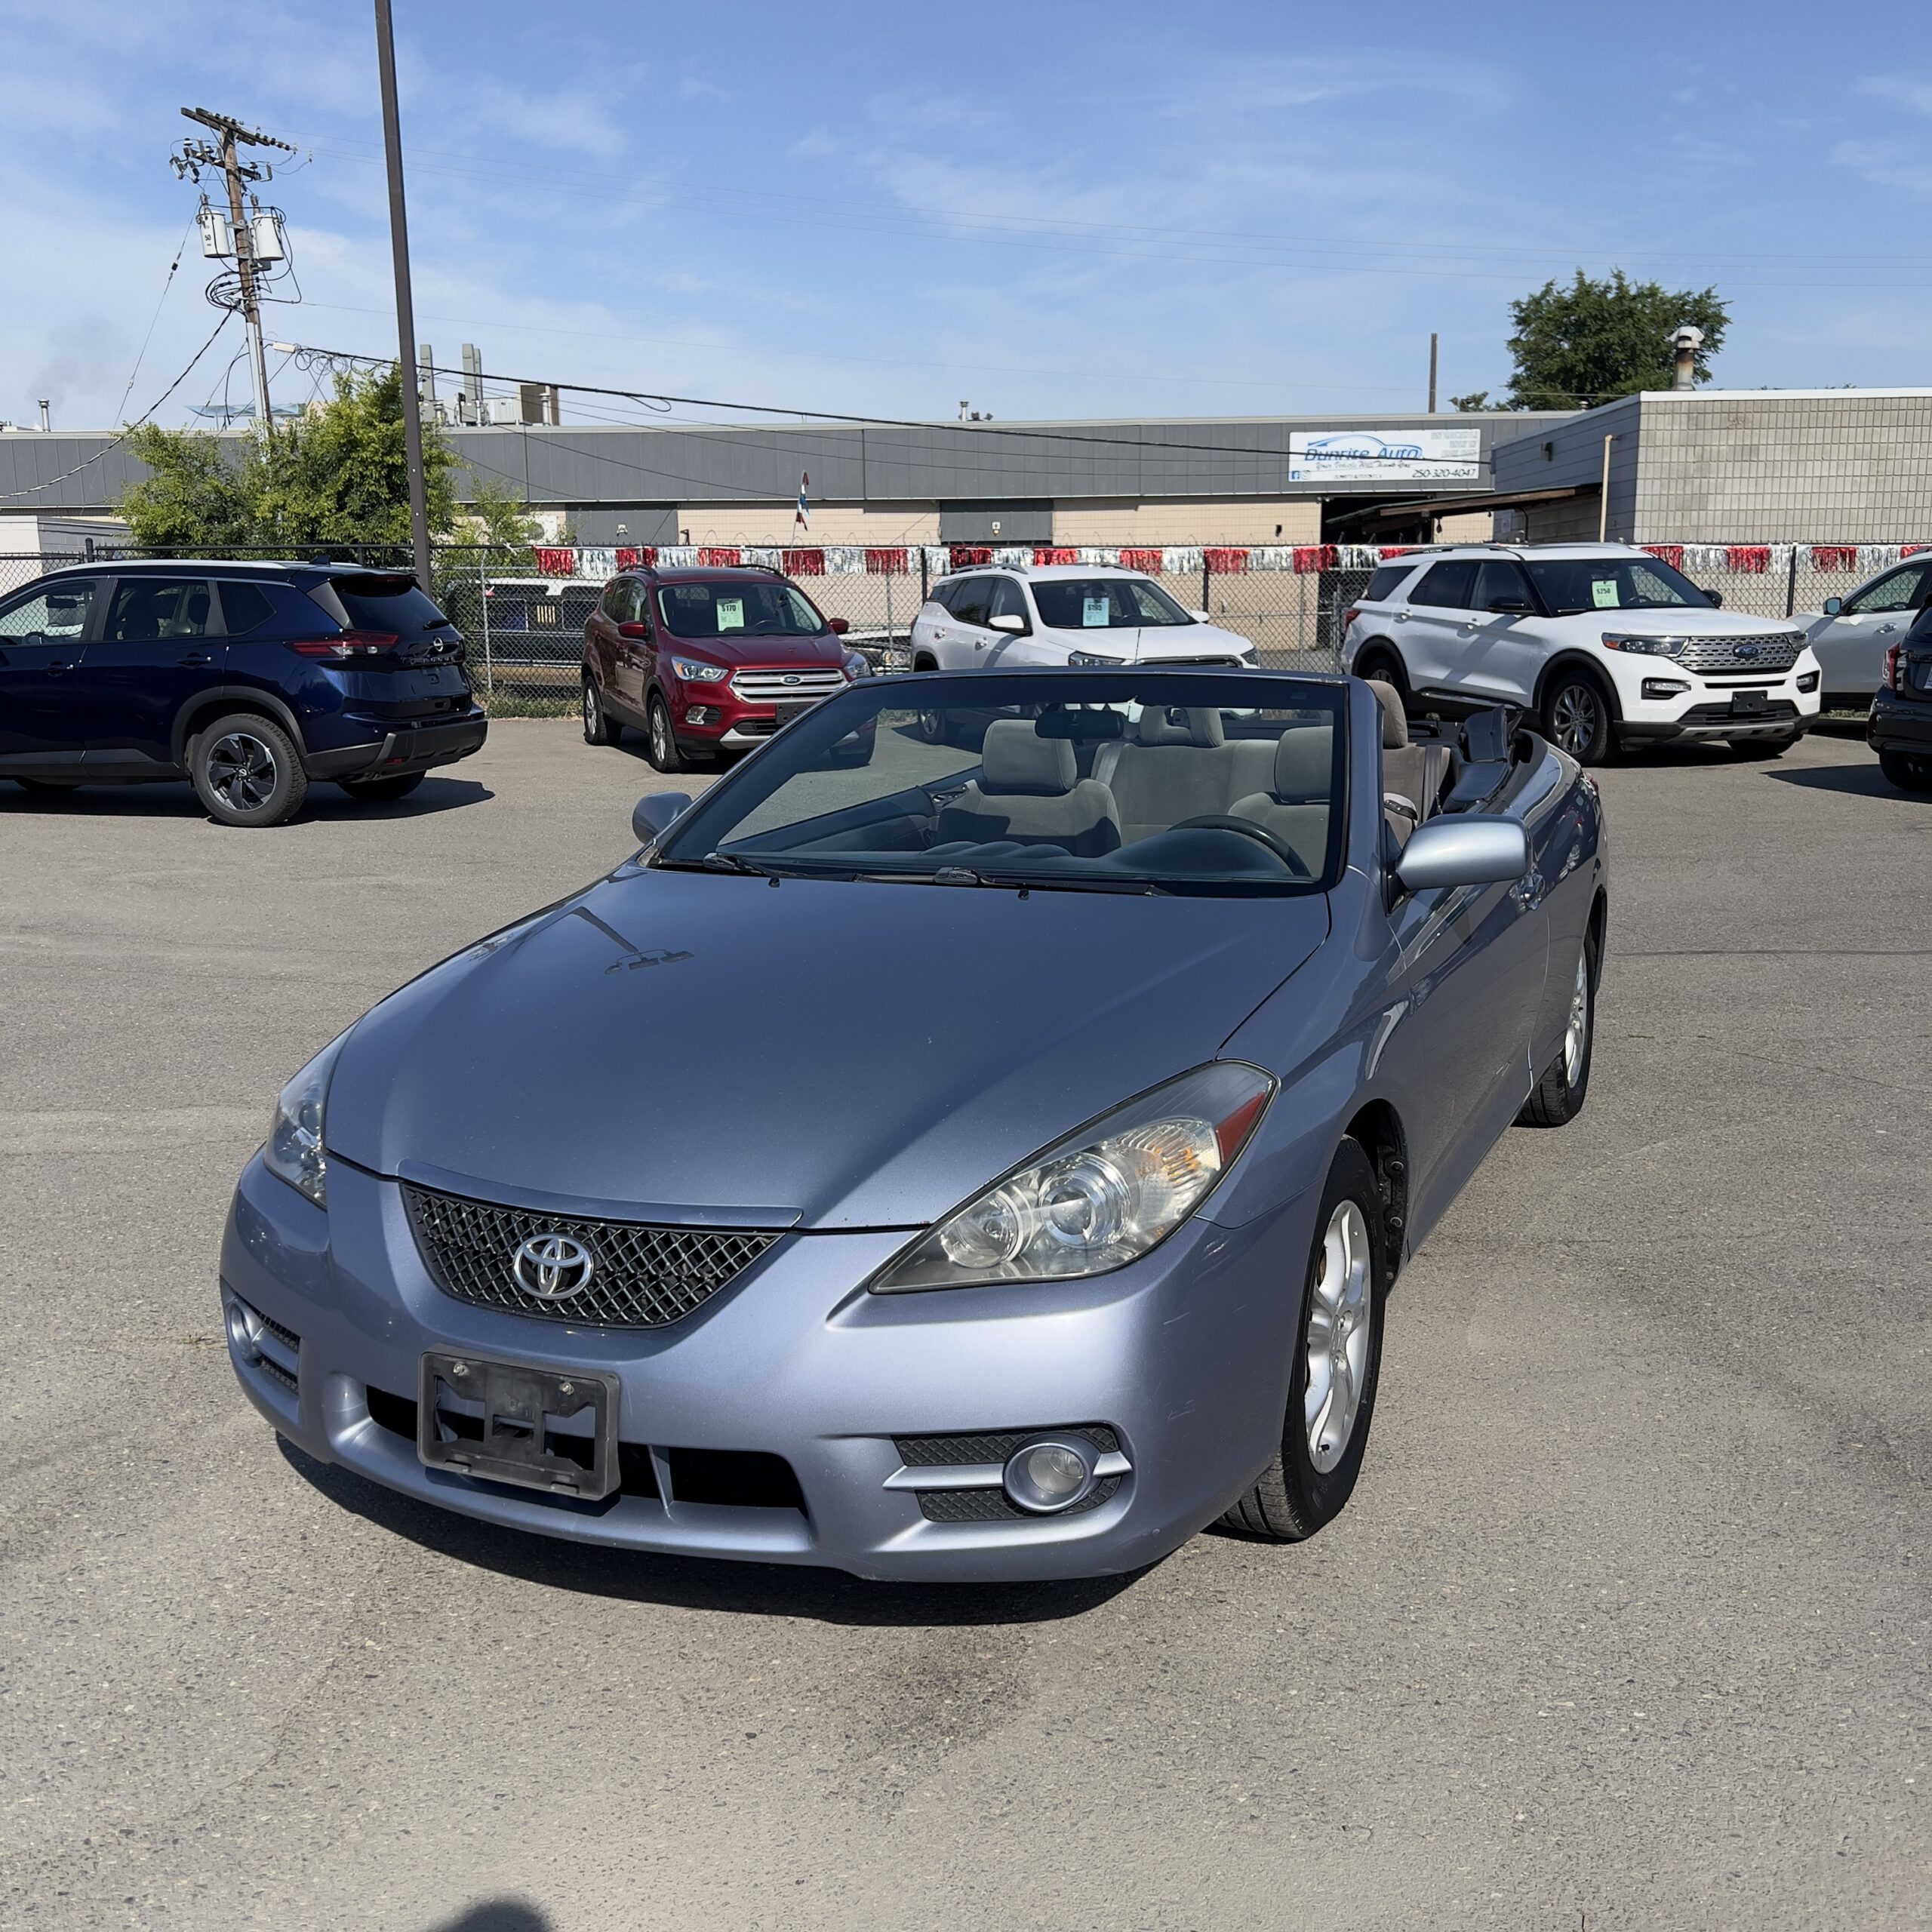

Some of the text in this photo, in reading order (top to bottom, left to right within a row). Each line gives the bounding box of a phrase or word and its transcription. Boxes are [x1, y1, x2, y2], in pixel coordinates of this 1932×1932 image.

[1377, 447, 1419, 460] Auto
[1412, 468, 1476, 478] 250-320-4047
[721, 604, 737, 612] $170
